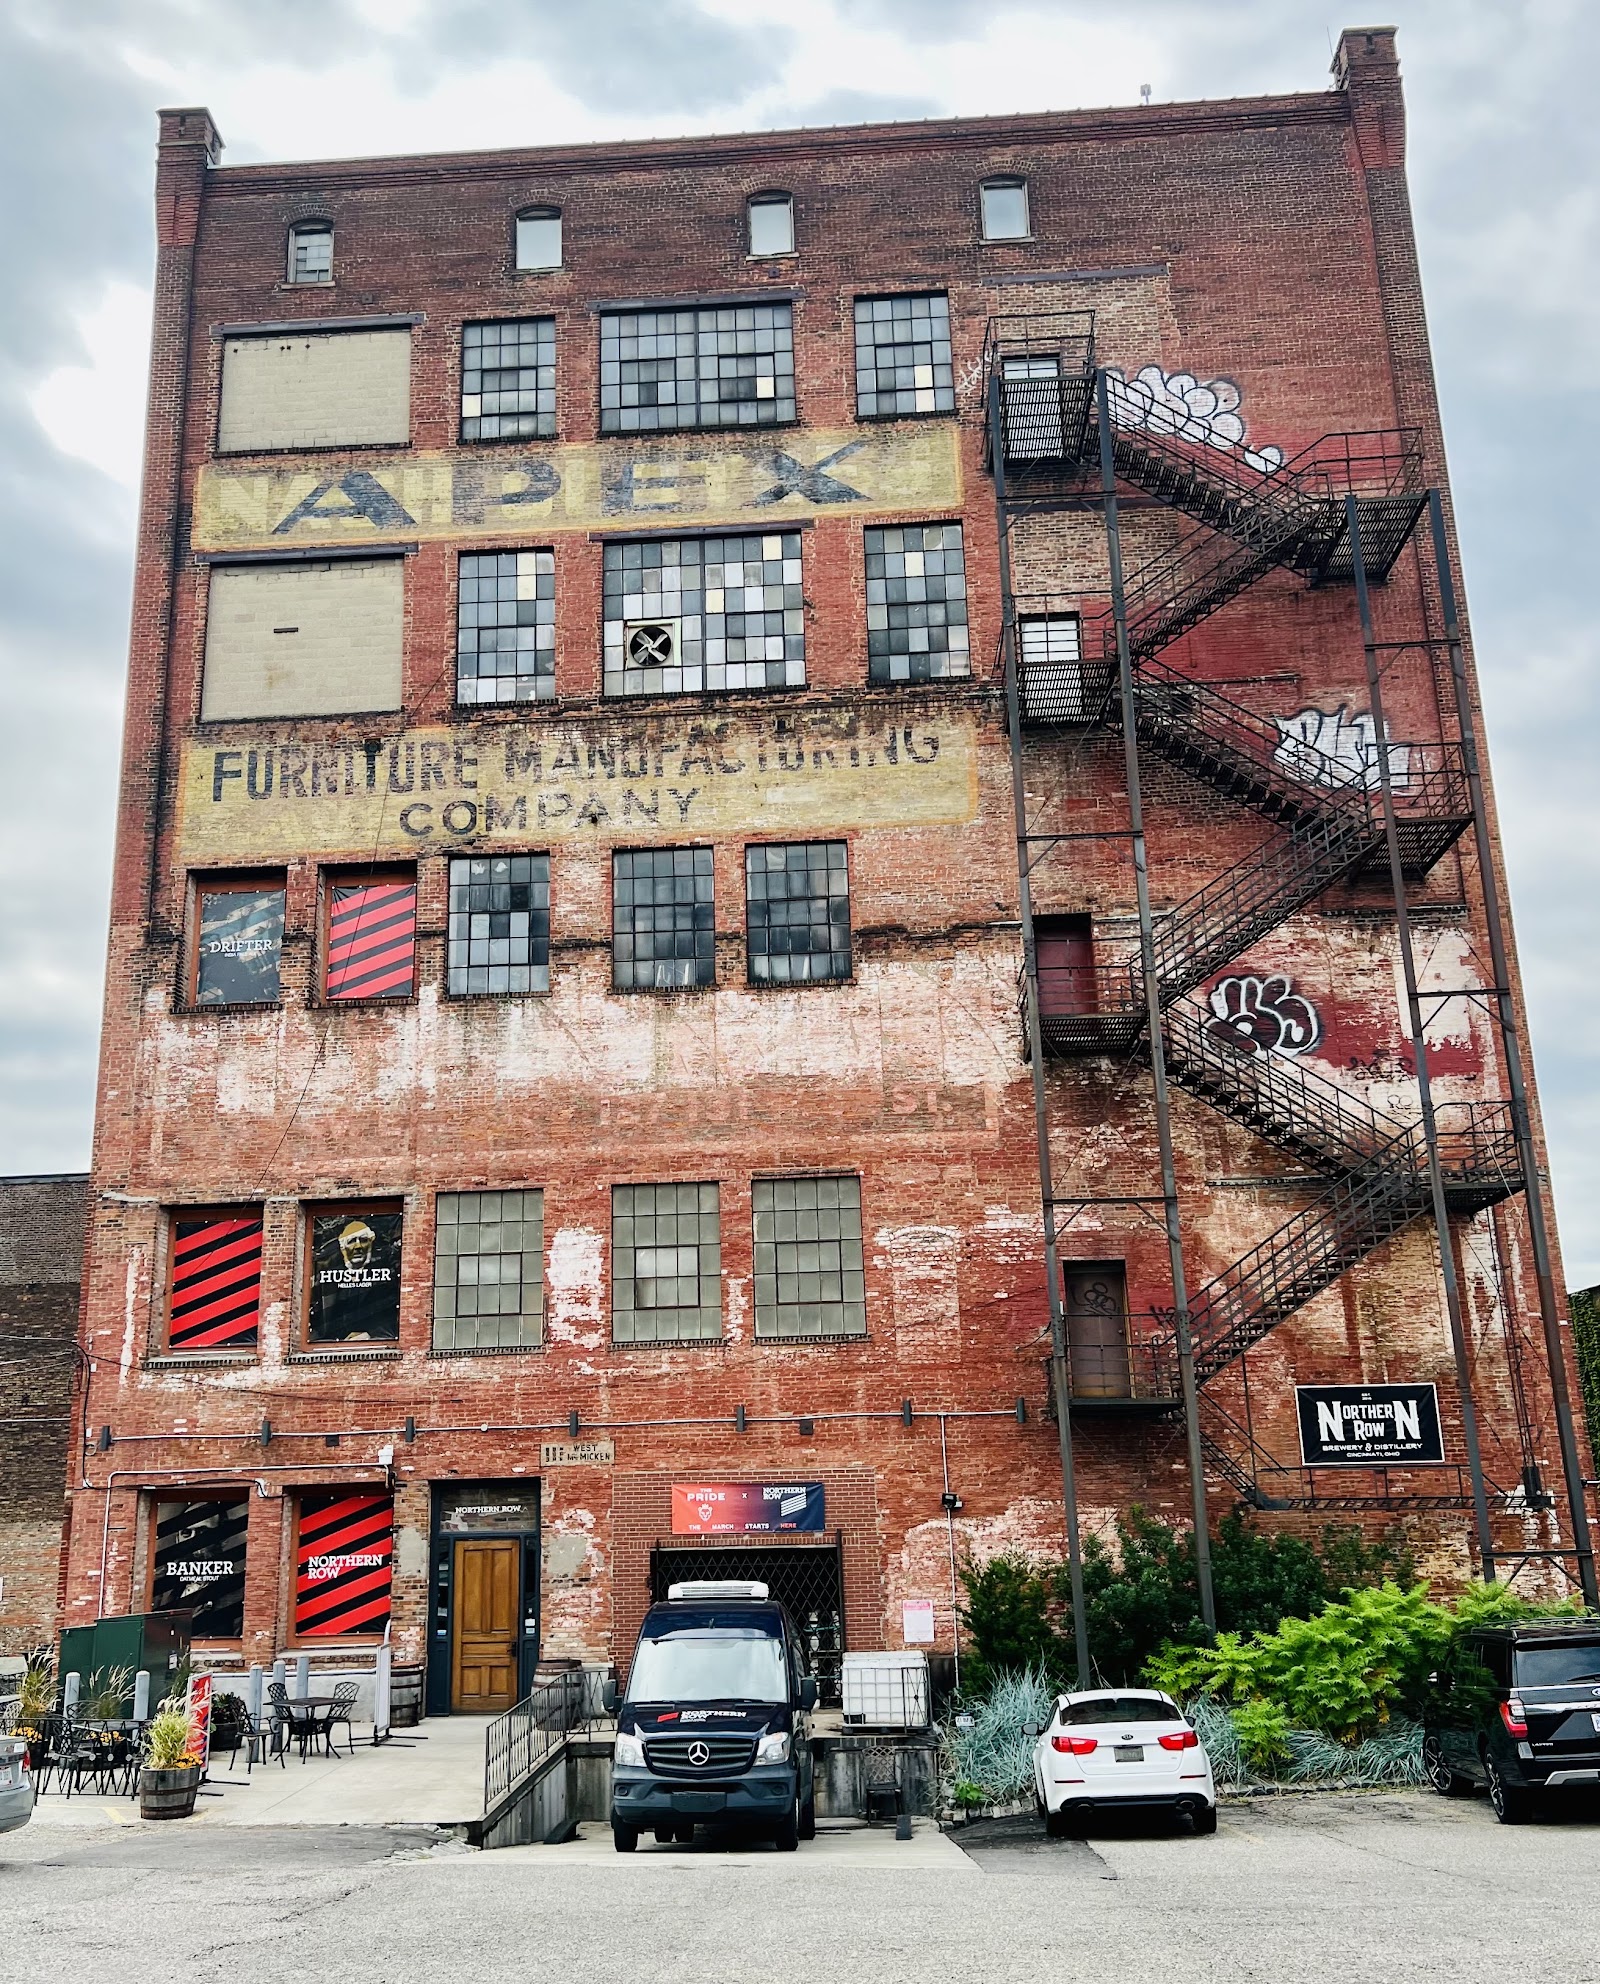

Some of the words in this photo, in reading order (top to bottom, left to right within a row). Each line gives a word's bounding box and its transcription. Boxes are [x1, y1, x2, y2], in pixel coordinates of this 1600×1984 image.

[271, 438, 874, 535] APEX
[212, 738, 479, 802] FURNITURE
[400, 787, 701, 837] COMPANY
[209, 939, 273, 953] DRIFTER
[320, 1268, 391, 1283] HUSTLER
[1316, 1400, 1421, 1441] NORTHERN
[1353, 1420, 1385, 1440] ROW
[573, 1444, 598, 1452] WEST
[1322, 1444, 1363, 1452] BREWERY
[1365, 1443, 1372, 1452] &
[687, 1492, 725, 1501] PRIDE
[455, 1506, 500, 1514] NORTHERN
[308, 1554, 383, 1568] NORTHERN
[166, 1561, 234, 1576] BANKER
[308, 1567, 340, 1579] ROW
[681, 1710, 747, 1718] NORTHERN
